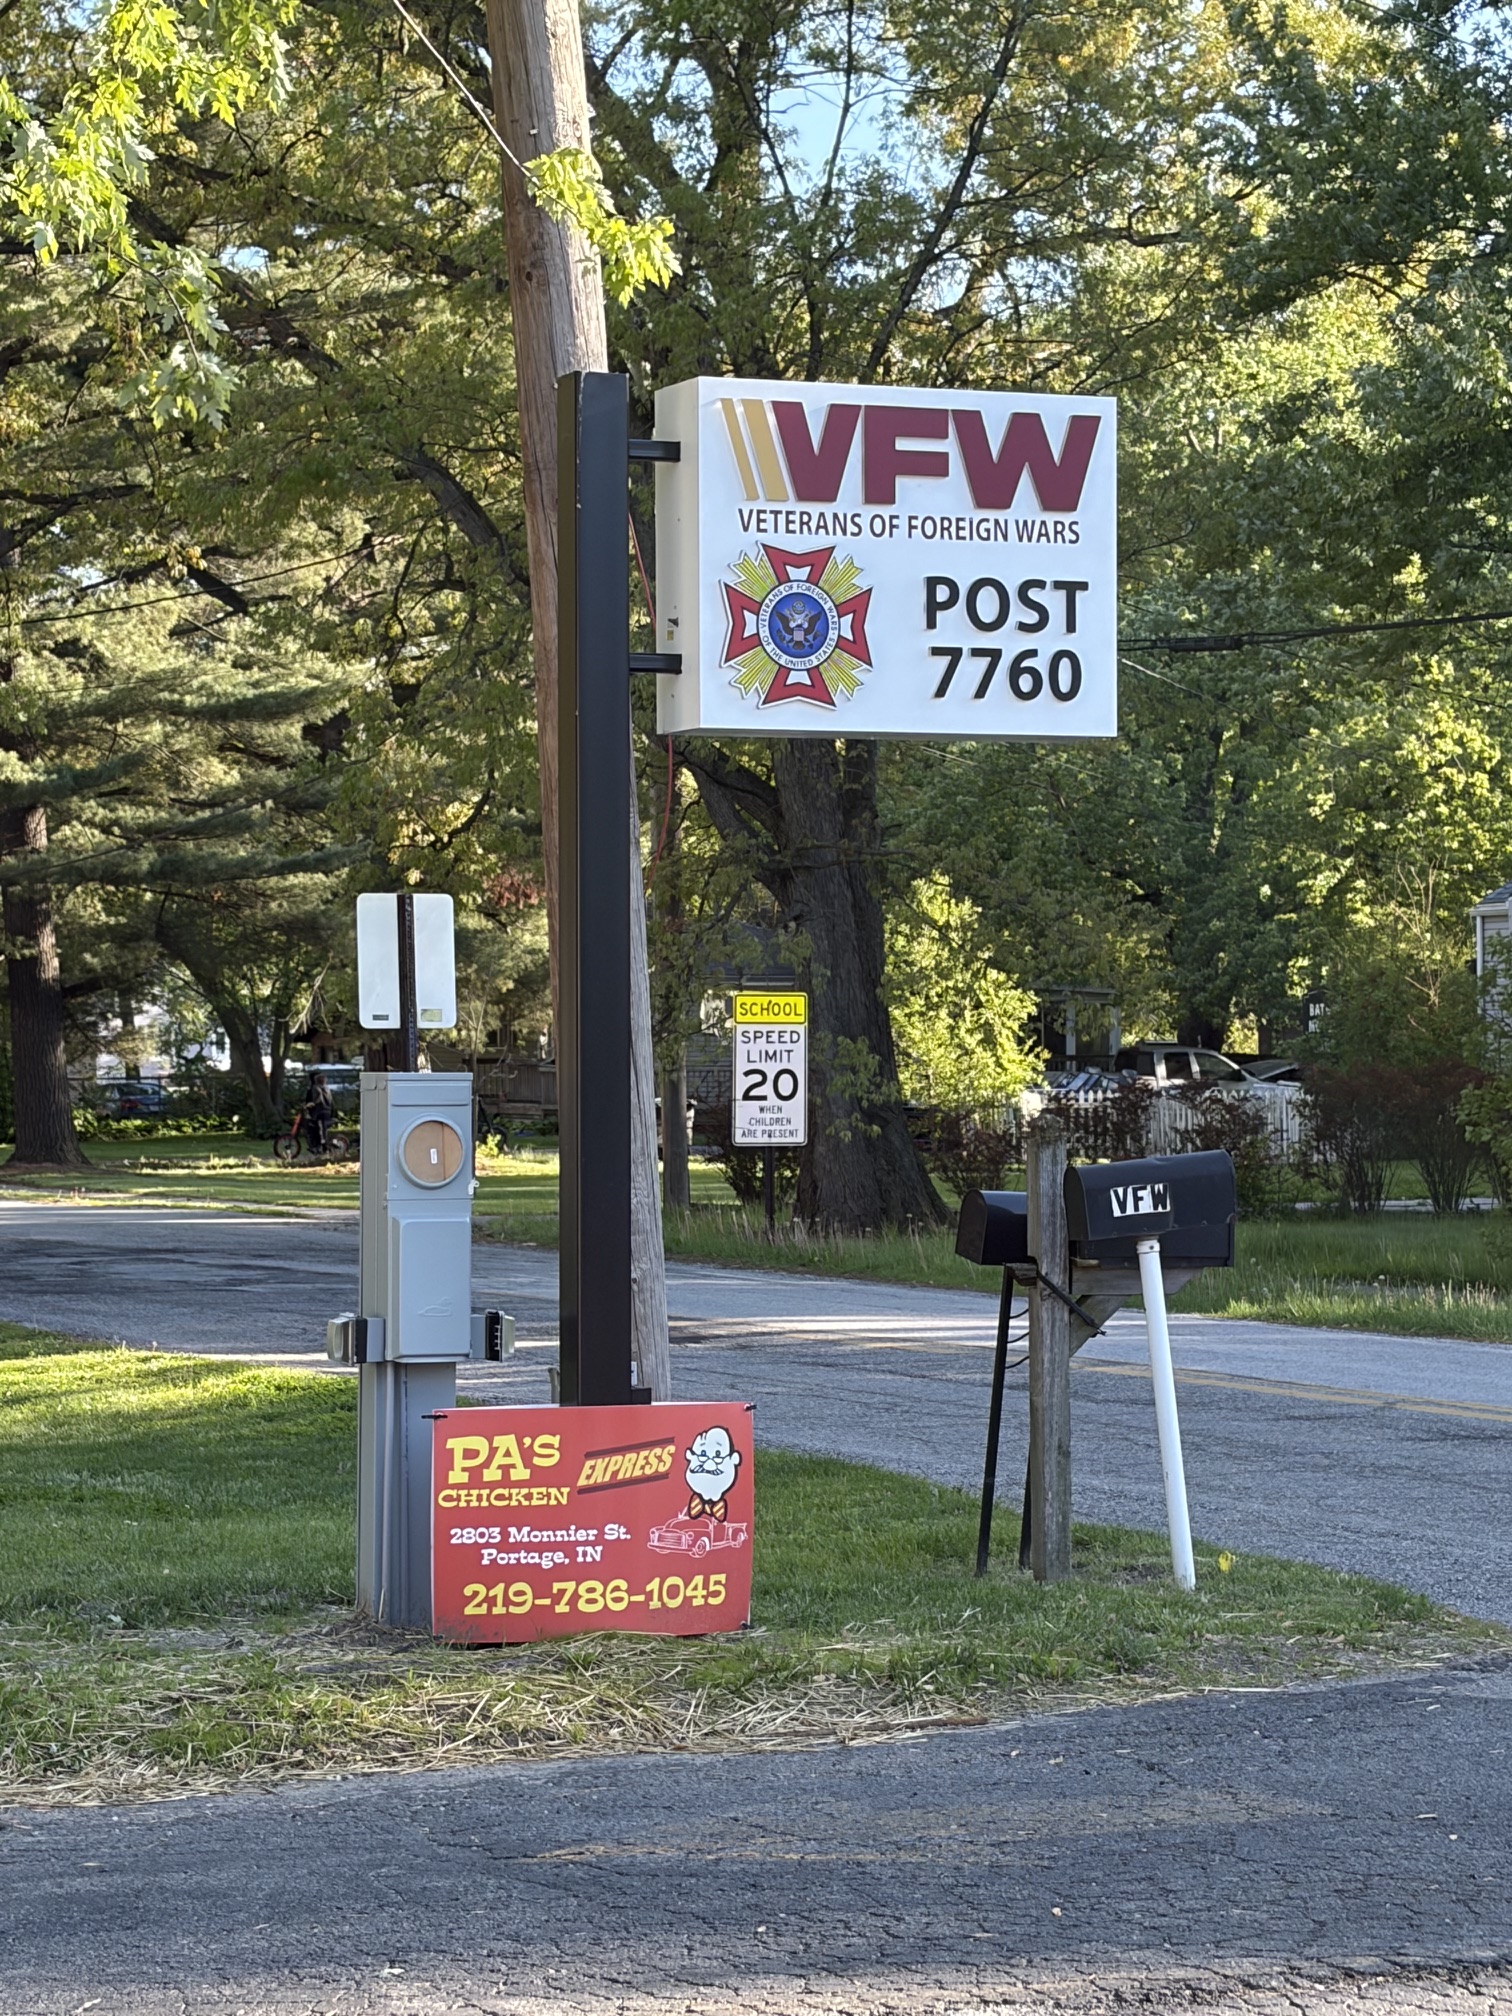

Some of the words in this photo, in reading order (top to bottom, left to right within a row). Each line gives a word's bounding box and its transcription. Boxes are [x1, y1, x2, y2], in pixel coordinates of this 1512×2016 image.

[770, 400, 1102, 512] VFW
[738, 508, 863, 537] VETERANS
[869, 512, 900, 539] OF
[907, 515, 1009, 542] FOREIGN
[1014, 519, 1080, 545] WARS
[761, 588, 783, 629] VETERANS
[783, 583, 794, 593] OF
[796, 583, 829, 605] FOREIGN
[827, 605, 838, 631] WARS
[924, 575, 1089, 635] POST
[762, 635, 772, 647] OF
[769, 648, 783, 661] THE
[784, 658, 814, 668] UNITED
[816, 637, 835, 662] STATES
[929, 646, 1083, 702] 7760
[739, 1002, 803, 1016] SCHOOL
[741, 1030, 800, 1044] SPEED
[747, 1050, 793, 1063] LIMIT
[742, 1068, 799, 1102] 20
[749, 1117, 791, 1126] CHILDREN
[758, 1105, 782, 1114] WHEN
[741, 1129, 757, 1138] ARE
[761, 1129, 798, 1138] PRESENT
[1112, 1184, 1169, 1214] VFW
[446, 1434, 561, 1484] PA'S
[577, 1445, 676, 1487] EXPRESS
[438, 1487, 570, 1508] CHICKEN
[450, 1526, 502, 1544] 2803
[508, 1525, 598, 1543] Monnier
[604, 1523, 631, 1540] St.
[481, 1548, 570, 1569] Portage,
[576, 1546, 603, 1562] IN
[463, 1573, 727, 1615] 219-786-1045
